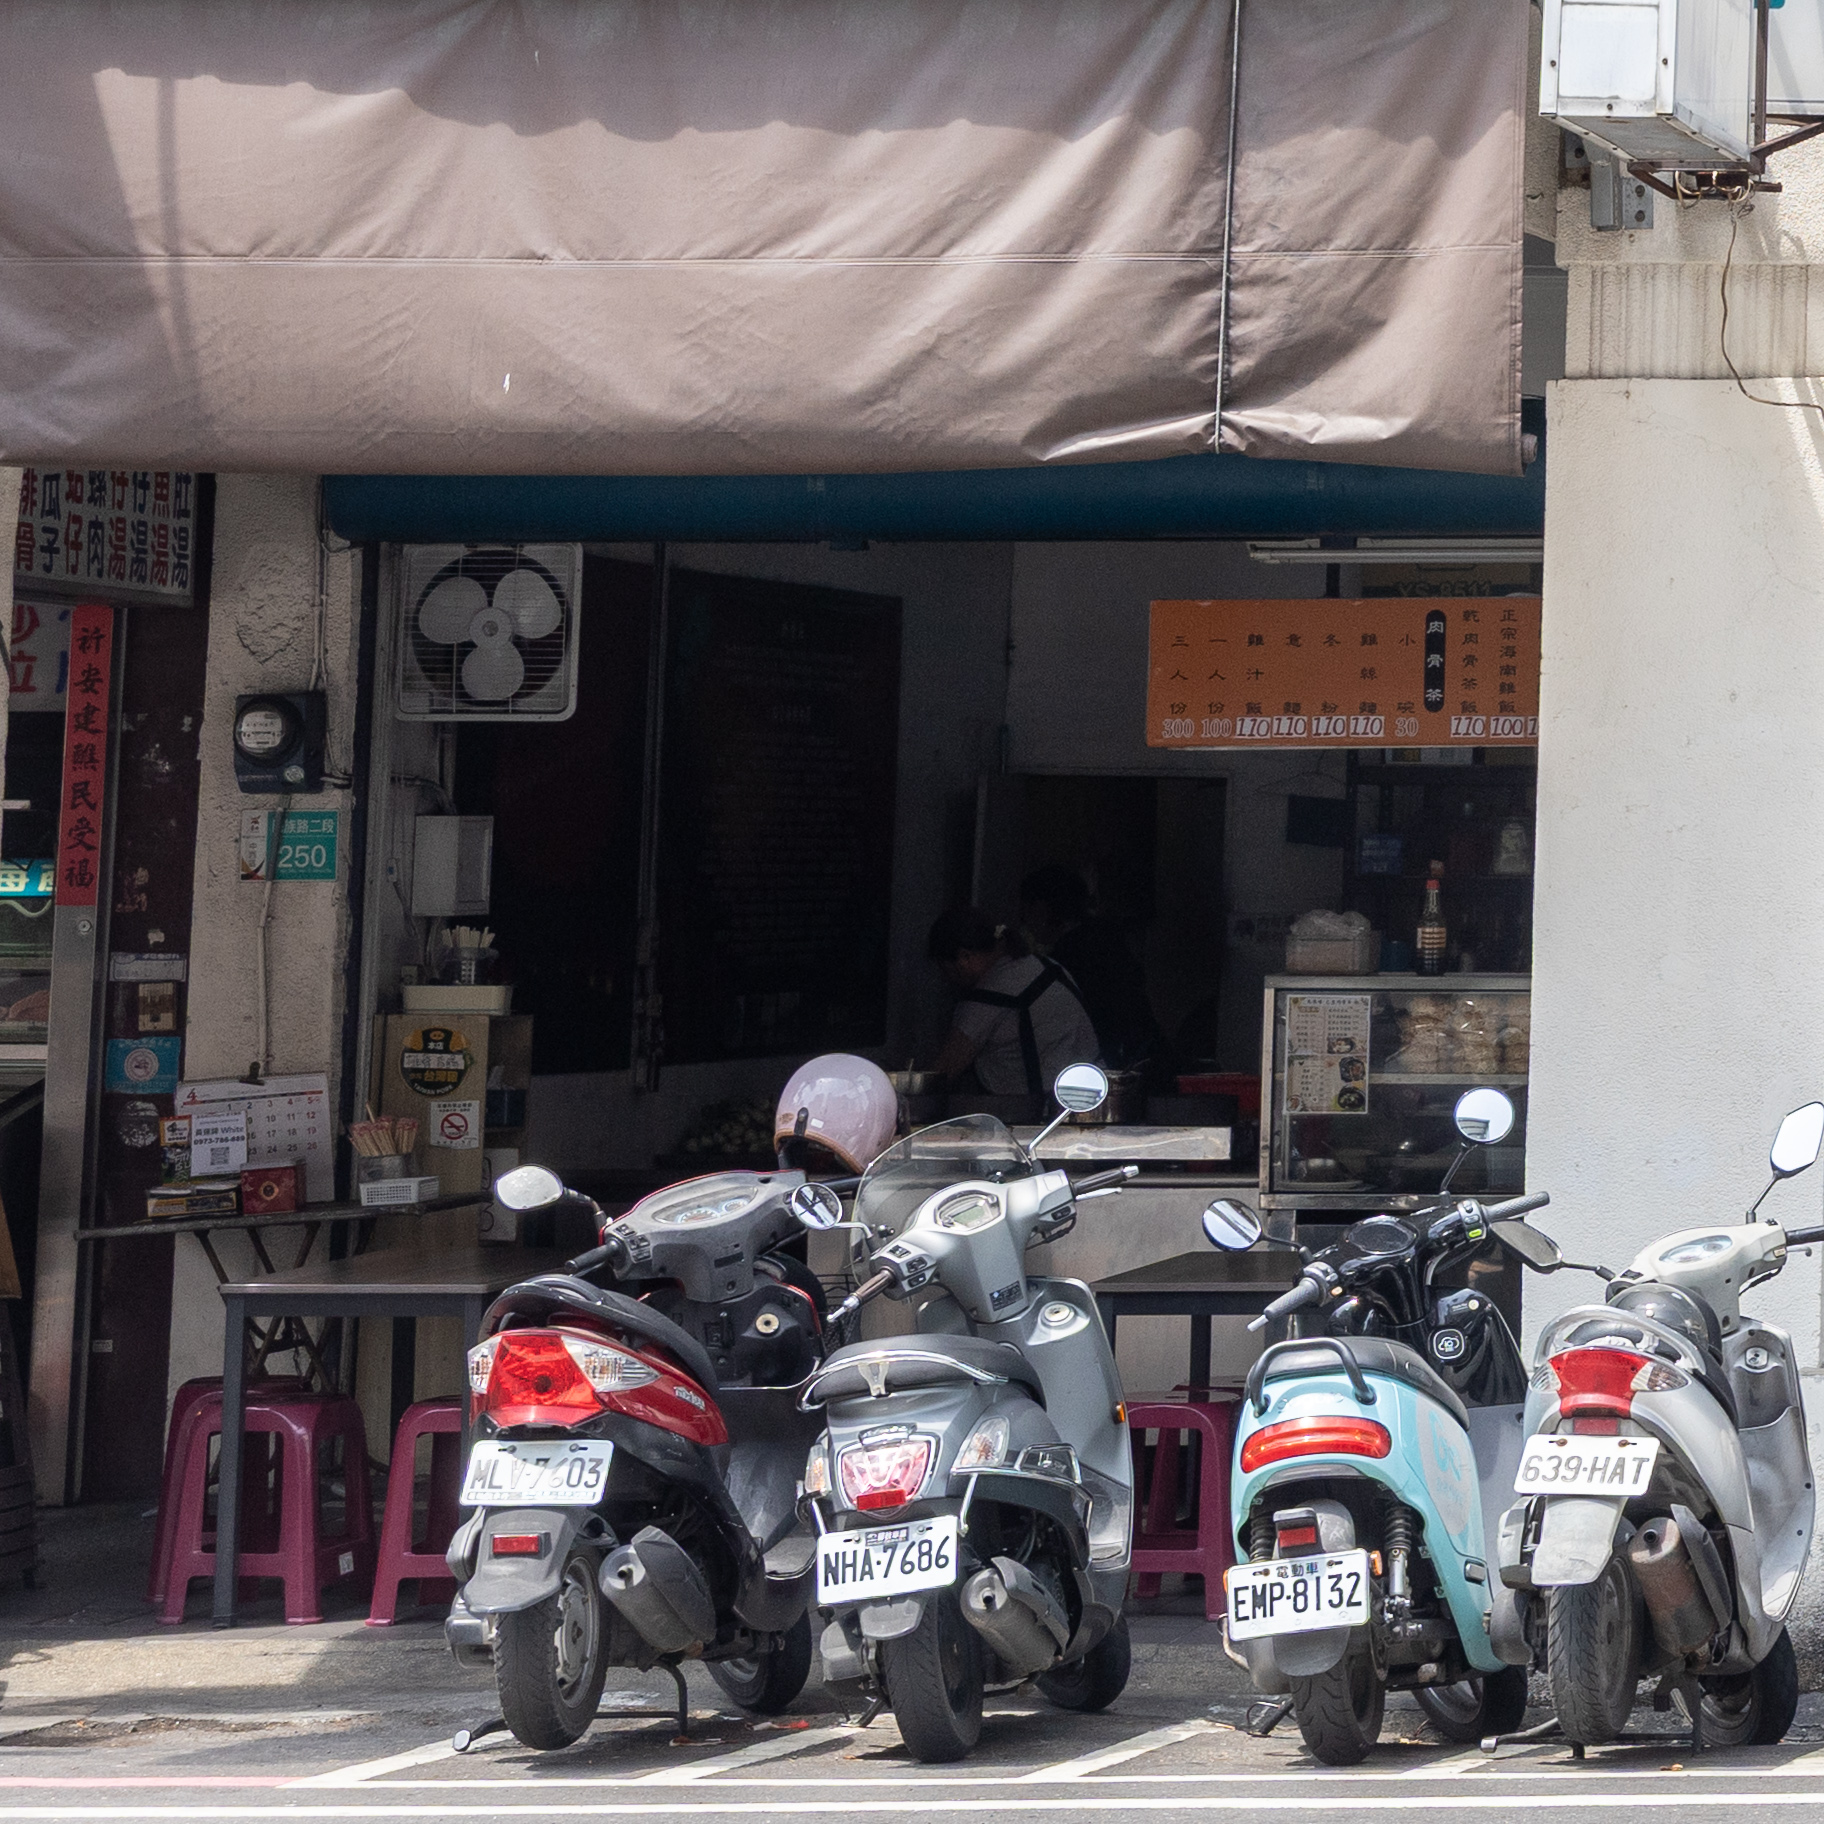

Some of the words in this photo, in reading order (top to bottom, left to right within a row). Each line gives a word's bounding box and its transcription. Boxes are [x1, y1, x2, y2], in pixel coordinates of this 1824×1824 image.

[1426, 621, 1445, 703] 肉骨茶
[1162, 719, 1195, 738] 300
[1201, 719, 1232, 738] 100
[1237, 717, 1270, 738] 110
[1274, 717, 1307, 738] 110
[1312, 717, 1346, 738] 110
[1350, 717, 1384, 737] 110
[1395, 718, 1418, 737] 30
[1452, 717, 1486, 737] 110
[1491, 717, 1524, 737] 100
[272, 819, 334, 834] 族路二段
[278, 844, 327, 868] 250
[306, 1111, 316, 1119] 12
[470, 1457, 604, 1490] MLV-7603
[1521, 1455, 1650, 1485] 639-HAT
[824, 1535, 949, 1587] NHA-7686
[1234, 1572, 1362, 1622] EMP-8132
